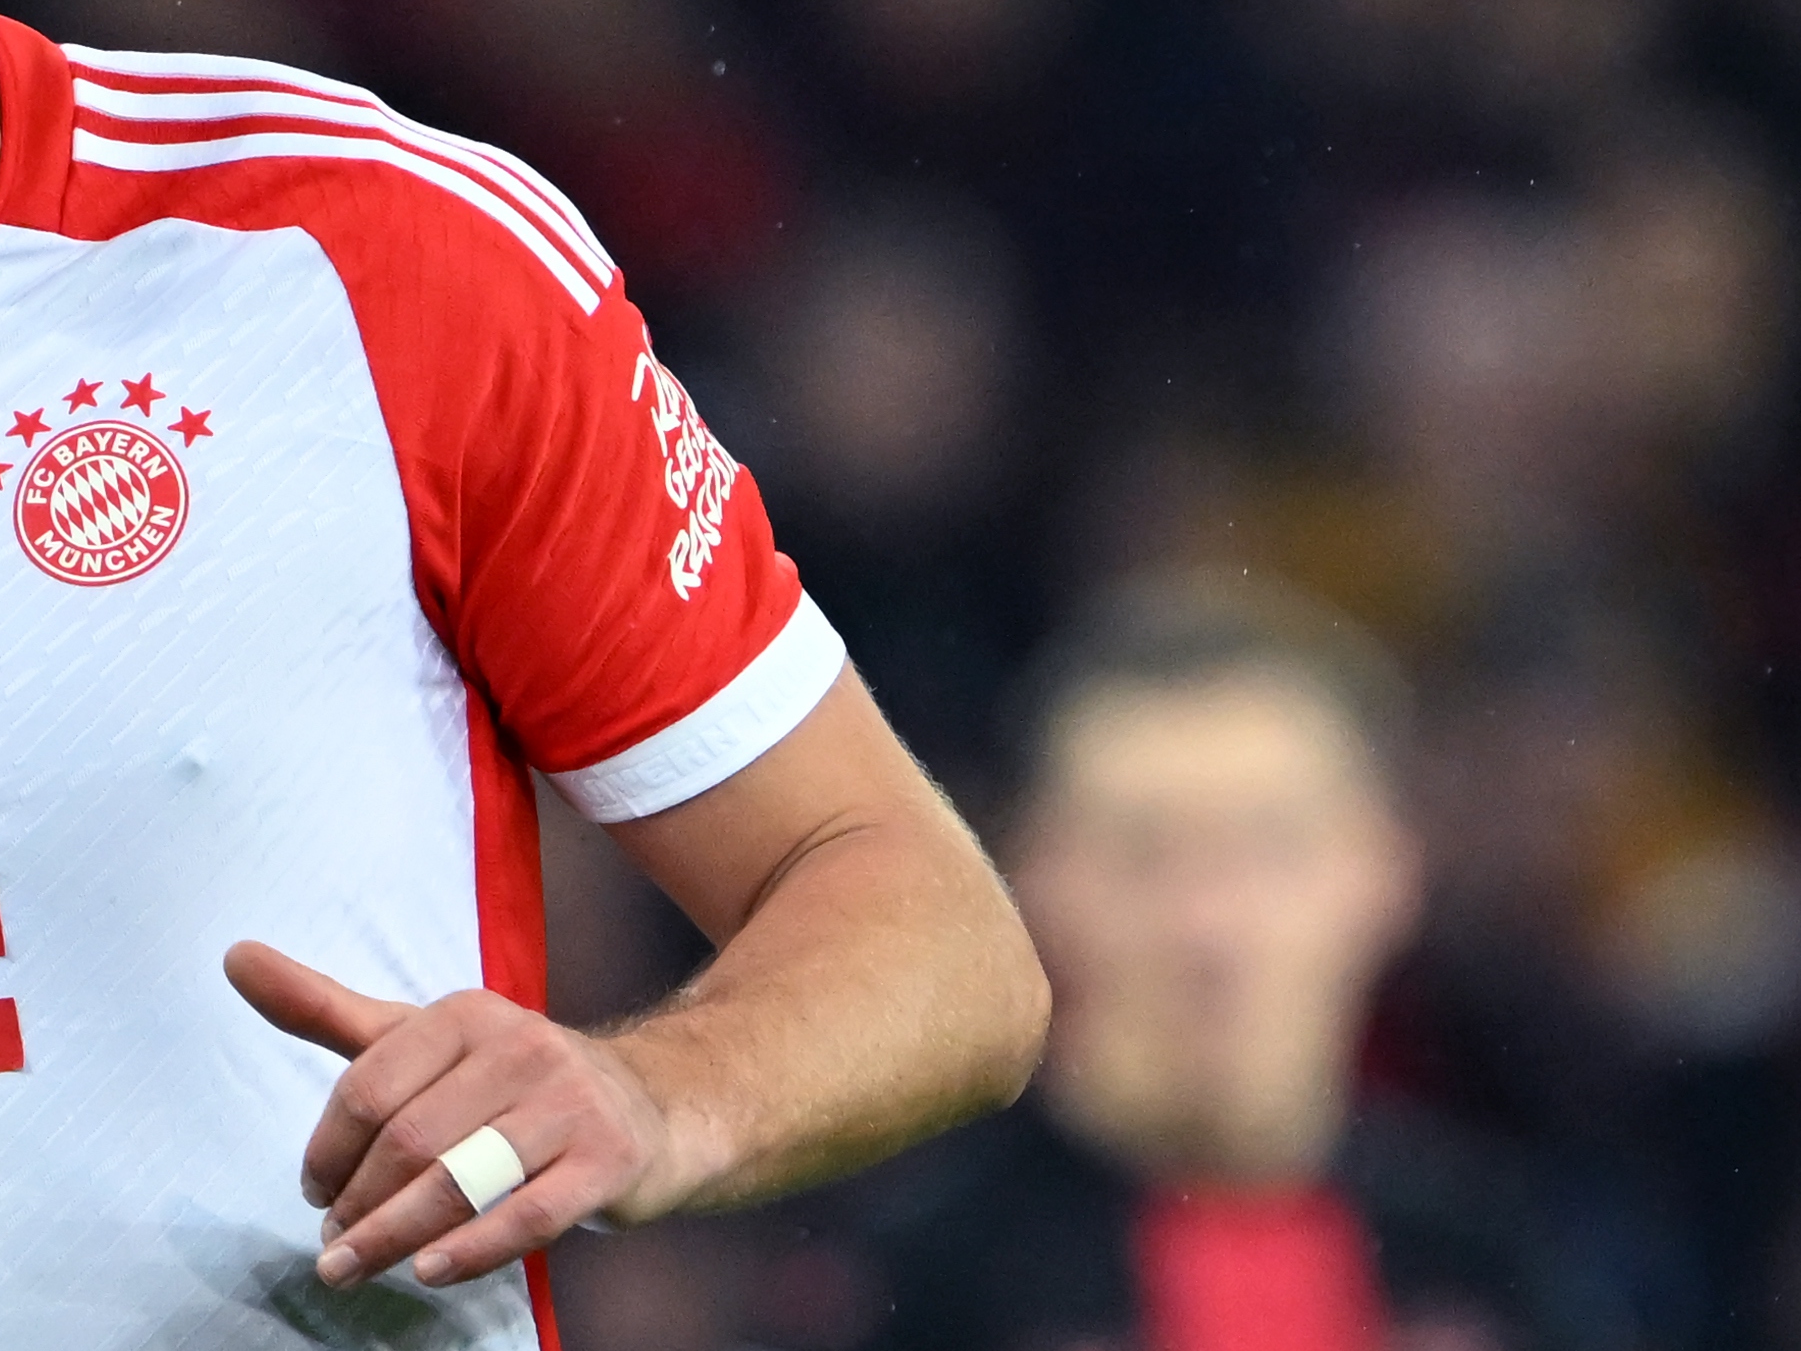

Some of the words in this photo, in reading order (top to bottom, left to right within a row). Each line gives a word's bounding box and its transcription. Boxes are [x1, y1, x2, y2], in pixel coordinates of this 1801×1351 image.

[26, 467, 56, 505] FC
[52, 430, 168, 480] BAYERN
[34, 504, 175, 574] MÜNCHEN
